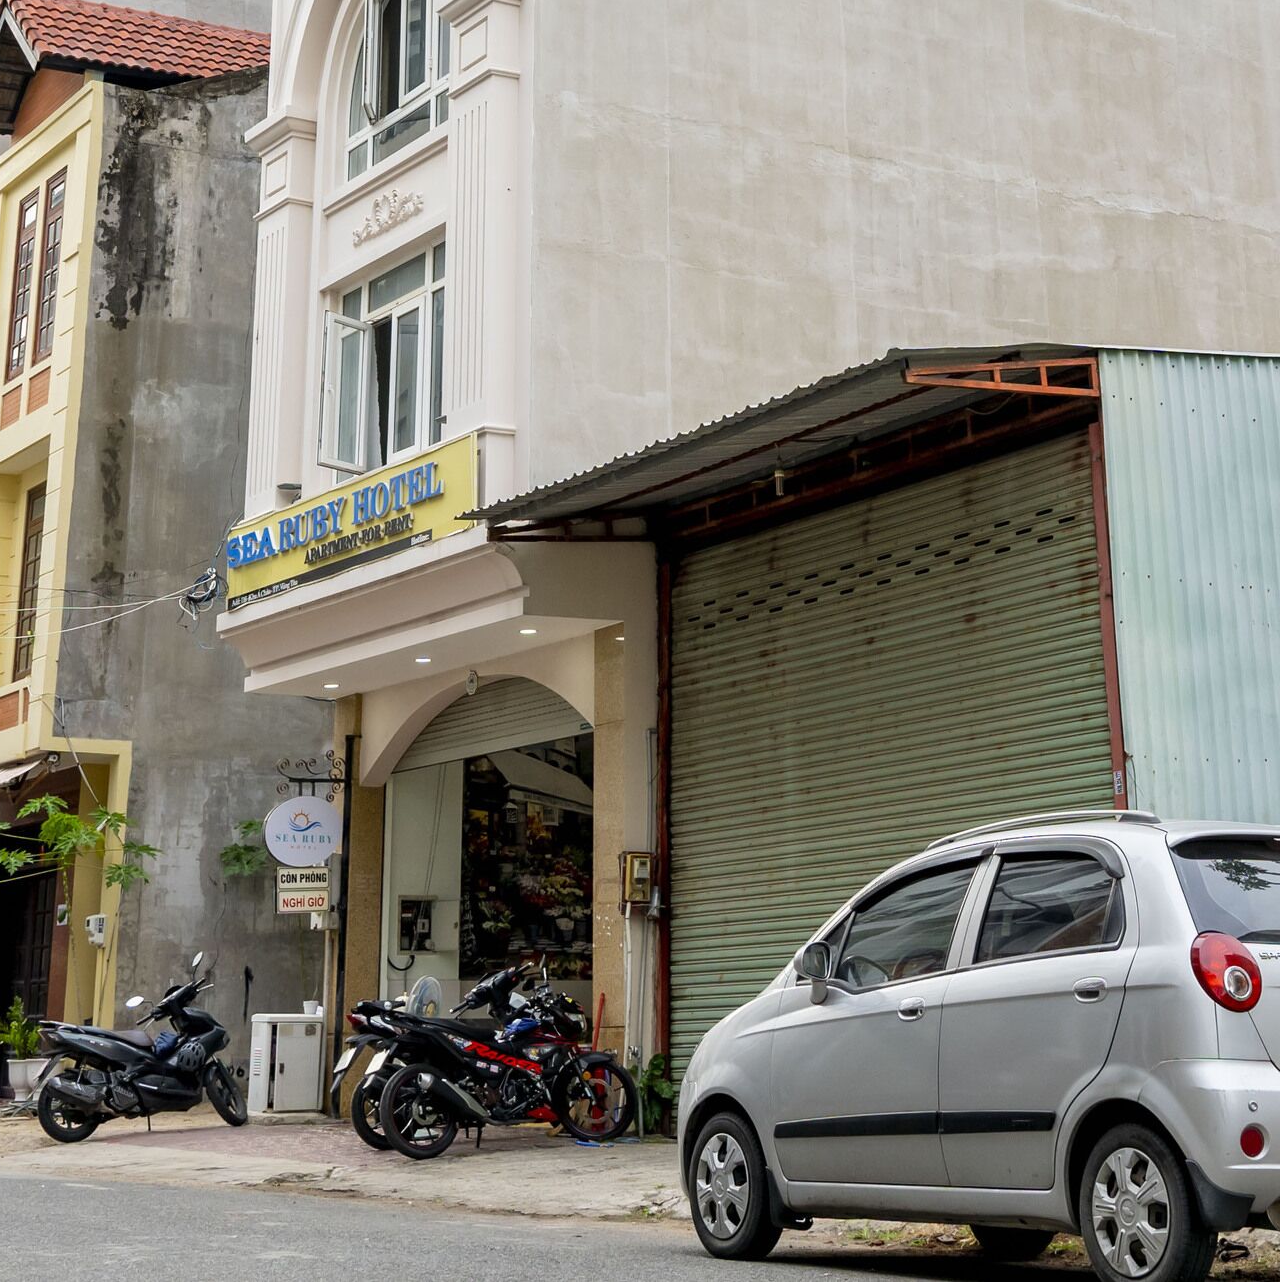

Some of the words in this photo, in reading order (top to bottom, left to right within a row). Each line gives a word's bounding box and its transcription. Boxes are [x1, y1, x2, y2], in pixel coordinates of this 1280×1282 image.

[226, 526, 279, 569] SEA
[278, 496, 348, 553] RUBY
[351, 461, 446, 526] HOTEL
[304, 531, 360, 565] APARTMENT
[361, 524, 382, 545] FOR
[383, 513, 414, 536] RENT
[275, 833, 297, 843] SEA
[302, 834, 332, 844] RUBY
[280, 871, 298, 884] CÒN
[299, 870, 327, 883] PHÒNG
[282, 894, 305, 909] NGHỈ
[307, 894, 325, 908] GIỜ
[464, 1040, 544, 1075] RAIDER
